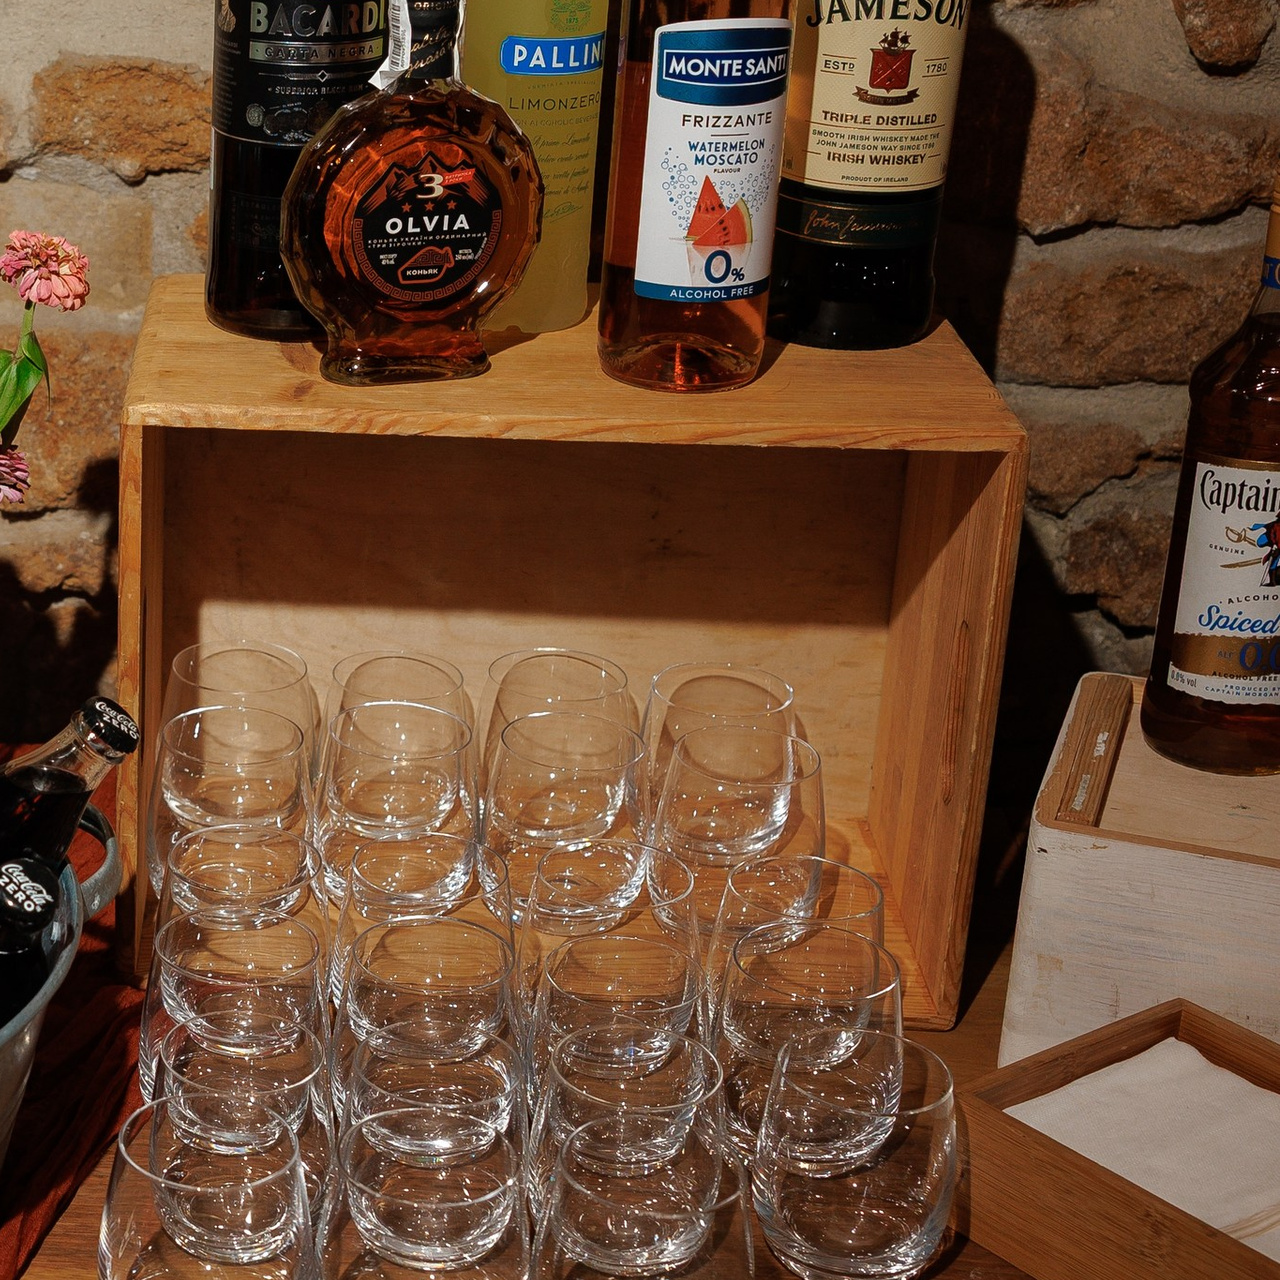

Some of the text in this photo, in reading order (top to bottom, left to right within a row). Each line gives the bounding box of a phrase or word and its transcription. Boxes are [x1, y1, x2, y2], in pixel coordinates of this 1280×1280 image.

[264, 44, 375, 61] CARTA NEGRA
[669, 53, 787, 78] MONTE SANTI
[925, 62, 948, 74] 1780
[275, 86, 319, 95] SUPERIOR
[509, 91, 600, 112] LIMONZERO
[682, 111, 773, 128] FRIZZANTE
[822, 110, 938, 126] TRIPLE DISTILLED
[811, 128, 846, 140] SMOOTH
[848, 134, 870, 142] IRISH
[872, 134, 908, 143] WHISKEY
[910, 134, 928, 142] MADE
[688, 138, 766, 153] WATERMELON
[816, 140, 837, 148] JOHN
[838, 142, 878, 151] JAMESON
[694, 152, 758, 166] MOSCATO
[827, 151, 926, 166] IRISH WHISKEY
[841, 174, 872, 182] PRODUCT
[416, 173, 444, 198] 3
[385, 214, 470, 235] OLVIA
[368, 231, 487, 244] КОНЬЯК УКРАЇНИ ОРДИНАРНИЙ
[406, 268, 438, 276] КОНЬЯК
[704, 250, 745, 284] 0%
[670, 286, 754, 299] ALCOHOL FREE
[1208, 544, 1245, 556] GENUINE
[1228, 594, 1280, 605] ALCOHO
[1198, 604, 1280, 634] Spiced
[1239, 642, 1280, 671] 0.0
[1186, 676, 1198, 688] vol
[1212, 670, 1278, 682] ALCOHOL FREE
[1205, 686, 1240, 696] CAPTAIN
[1224, 684, 1269, 692] PRODUCED
[102, 713, 138, 740] ZERO
